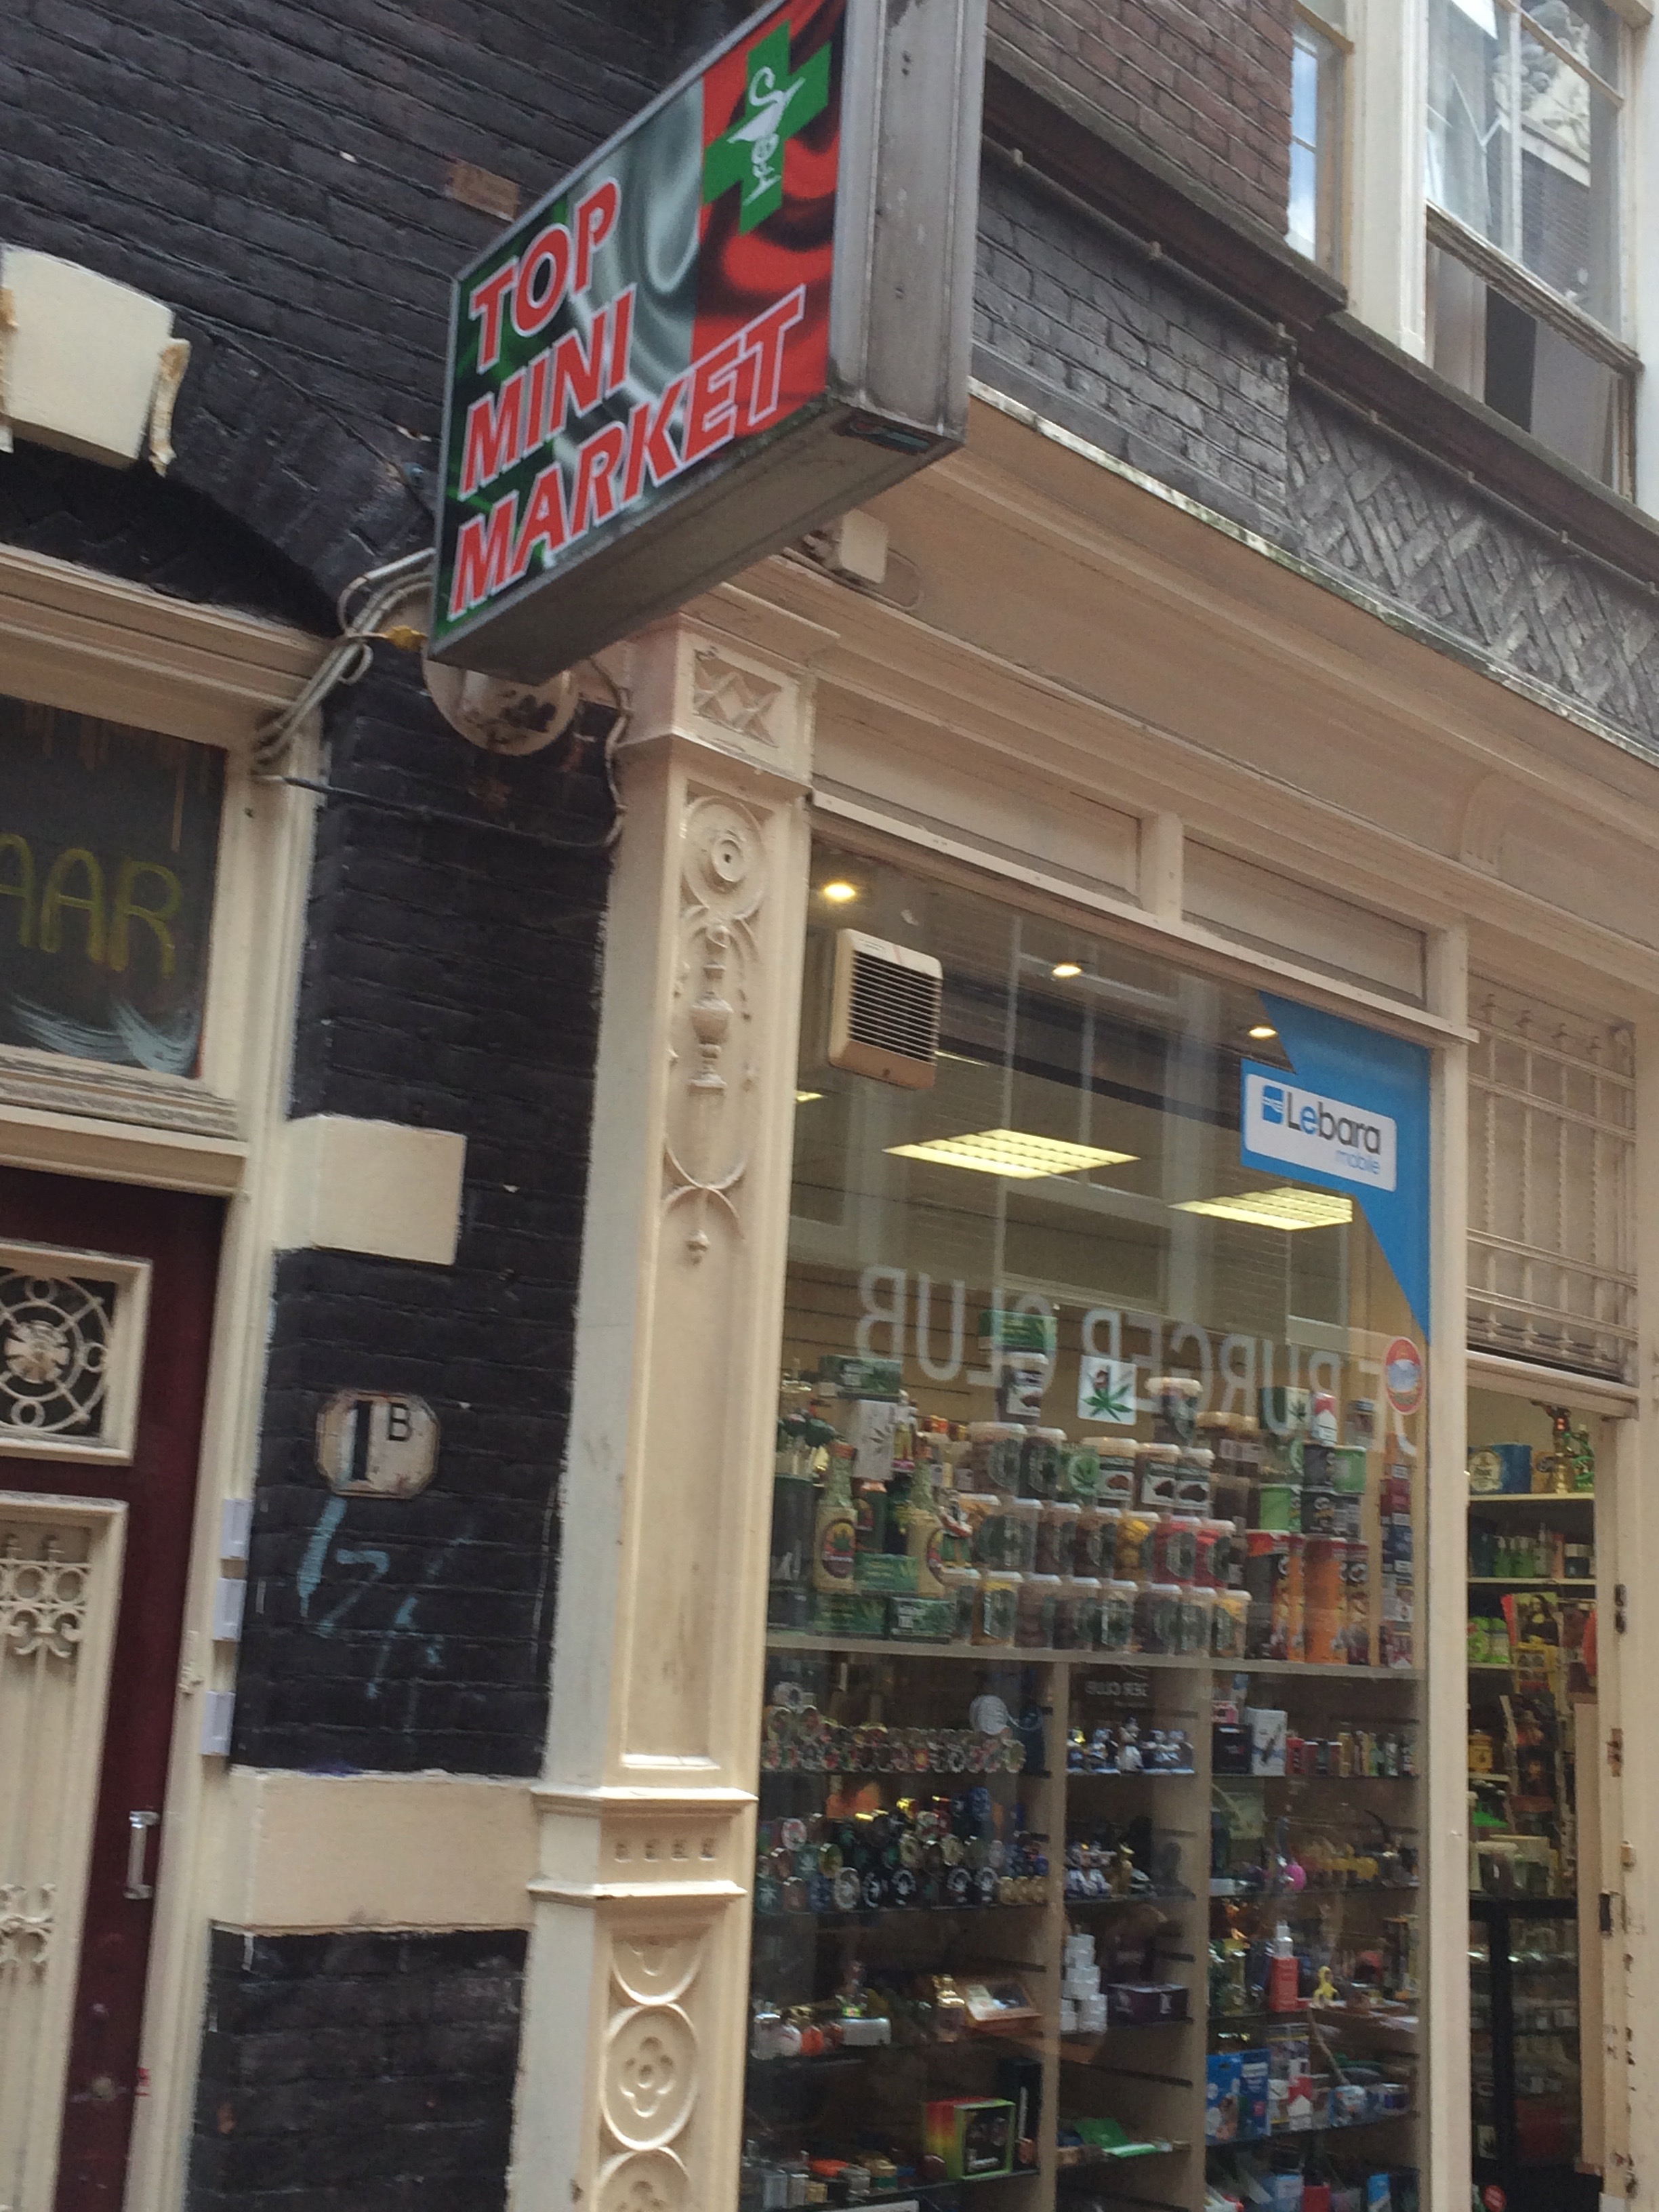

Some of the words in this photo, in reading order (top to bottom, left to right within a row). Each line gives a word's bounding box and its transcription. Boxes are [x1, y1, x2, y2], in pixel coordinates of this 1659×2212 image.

[469, 178, 621, 373] TOP
[447, 284, 806, 621] MARKET
[458, 283, 638, 500] MINI
[1286, 1091, 1381, 1155] Lebara
[349, 1399, 413, 1481] 1B
